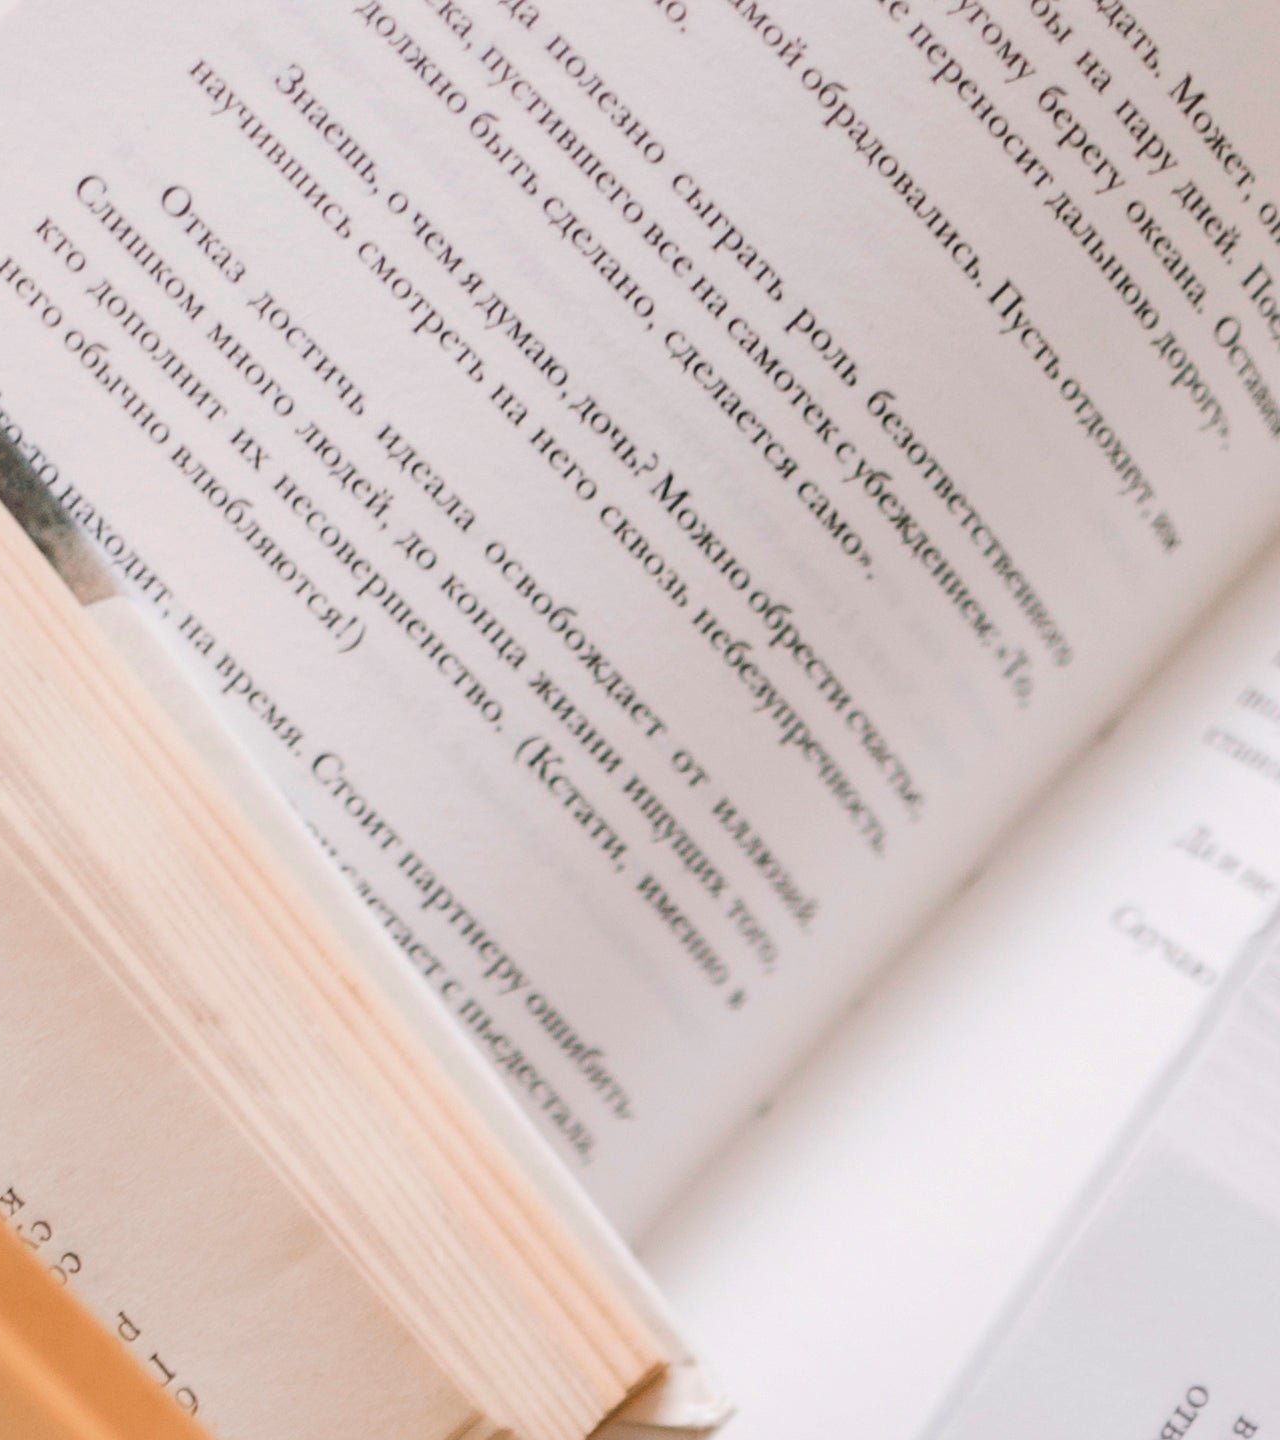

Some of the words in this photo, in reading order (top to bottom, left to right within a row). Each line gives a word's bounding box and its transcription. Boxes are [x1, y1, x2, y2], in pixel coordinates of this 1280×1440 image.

[186, 58, 353, 241] научившись
[356, 240, 486, 385] смотреть
[488, 381, 529, 429] на
[527, 426, 599, 503] него
[598, 503, 690, 609] сквозь
[543, 32, 667, 166] полезно
[670, 171, 785, 304] сыграть
[781, 305, 859, 389] роль
[62, 328, 172, 446] обычно
[168, 442, 368, 655] влюбляются!)
[83, 277, 229, 423] дополнит
[228, 425, 272, 474] их
[270, 472, 505, 734] несовершенство.
[159, 183, 248, 286] Отказ
[245, 289, 366, 418] достичь
[374, 422, 477, 535] идеала
[483, 539, 669, 740] освобождает
